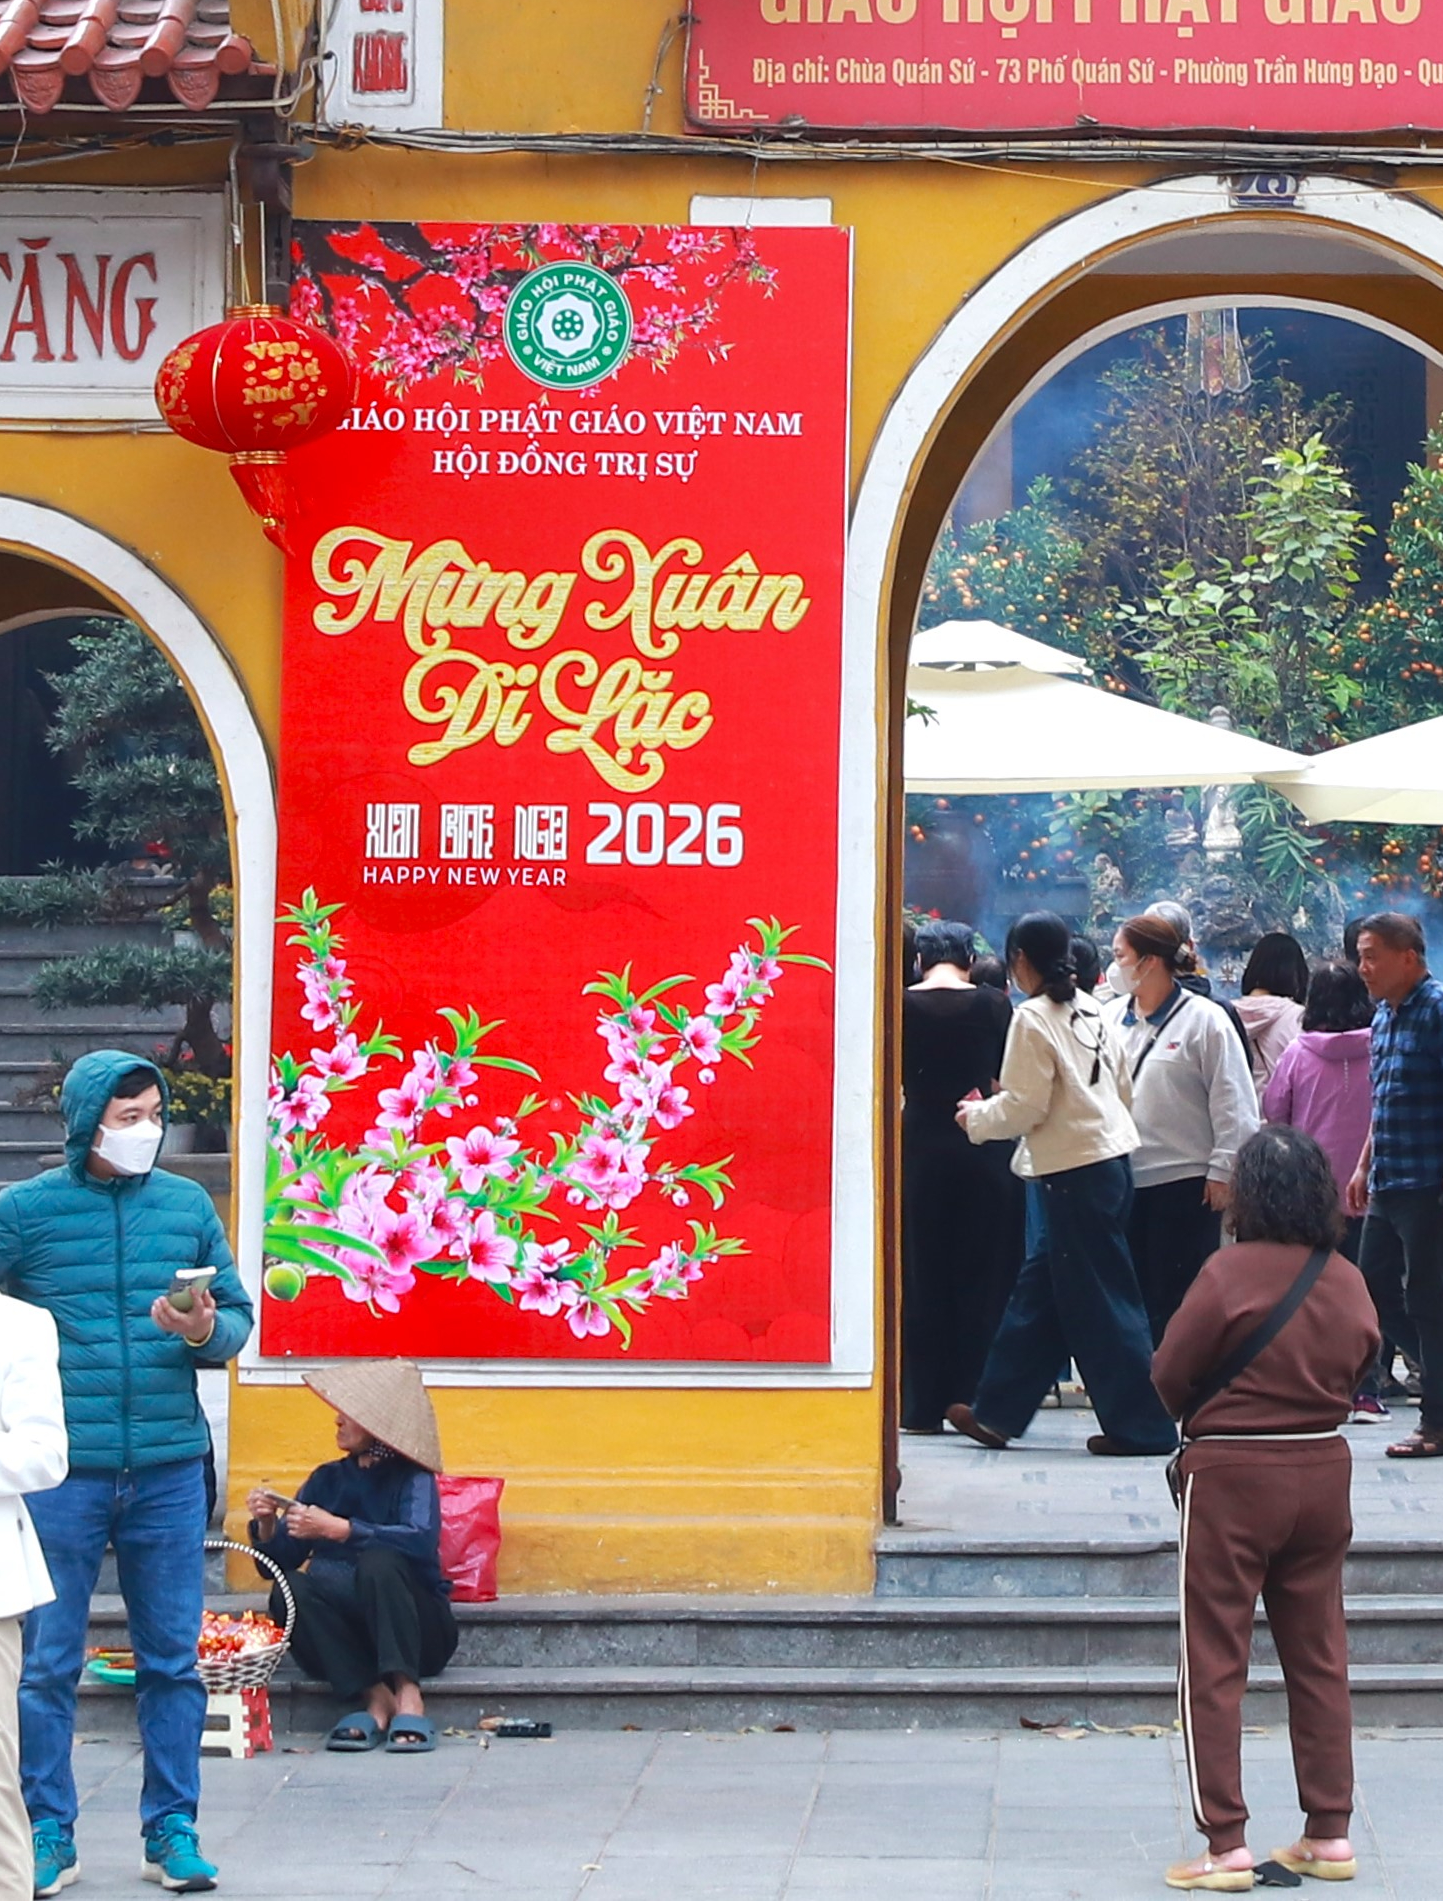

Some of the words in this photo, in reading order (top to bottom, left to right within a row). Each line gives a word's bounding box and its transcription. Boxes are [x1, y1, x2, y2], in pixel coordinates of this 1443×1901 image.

[753, 58, 786, 88] Địa
[792, 55, 829, 83] chỉ:
[836, 57, 886, 84] Chùa
[892, 57, 943, 87] Quán
[948, 57, 977, 84] Sứ
[995, 58, 1021, 84] 73
[1027, 53, 1067, 84] Phố
[1072, 56, 1122, 87] Quán
[1127, 57, 1155, 84] Sứ
[1174, 56, 1248, 87] Phường
[1254, 54, 1298, 84] Trần
[1303, 58, 1354, 87] Hưng
[1359, 58, 1398, 89] Đạo
[514, 299, 534, 341] GIÁO
[530, 275, 560, 299] HỘI
[563, 273, 609, 298] PHẬT
[603, 299, 624, 342] GIÁO
[533, 353, 566, 377] VIỆT
[566, 355, 602, 377] NAM
[336, 401, 405, 434] IÁO
[413, 401, 470, 438] HỘI
[479, 401, 562, 439] PHẬT
[569, 404, 646, 435] GIÁO
[653, 404, 727, 441] VIỆT
[733, 412, 803, 436] NAM
[432, 443, 490, 480] HỘI
[497, 439, 587, 476] ĐỒNG
[594, 452, 648, 482] TRỊ
[655, 450, 699, 483] SỰ
[311, 525, 576, 656] Mừng
[581, 528, 811, 659] Xuân
[401, 648, 537, 767] Di
[538, 647, 715, 793] Lặc
[586, 801, 745, 867] 2026
[363, 866, 440, 884] HAPPY
[448, 867, 501, 885] NEW
[507, 867, 567, 886] YEAR
